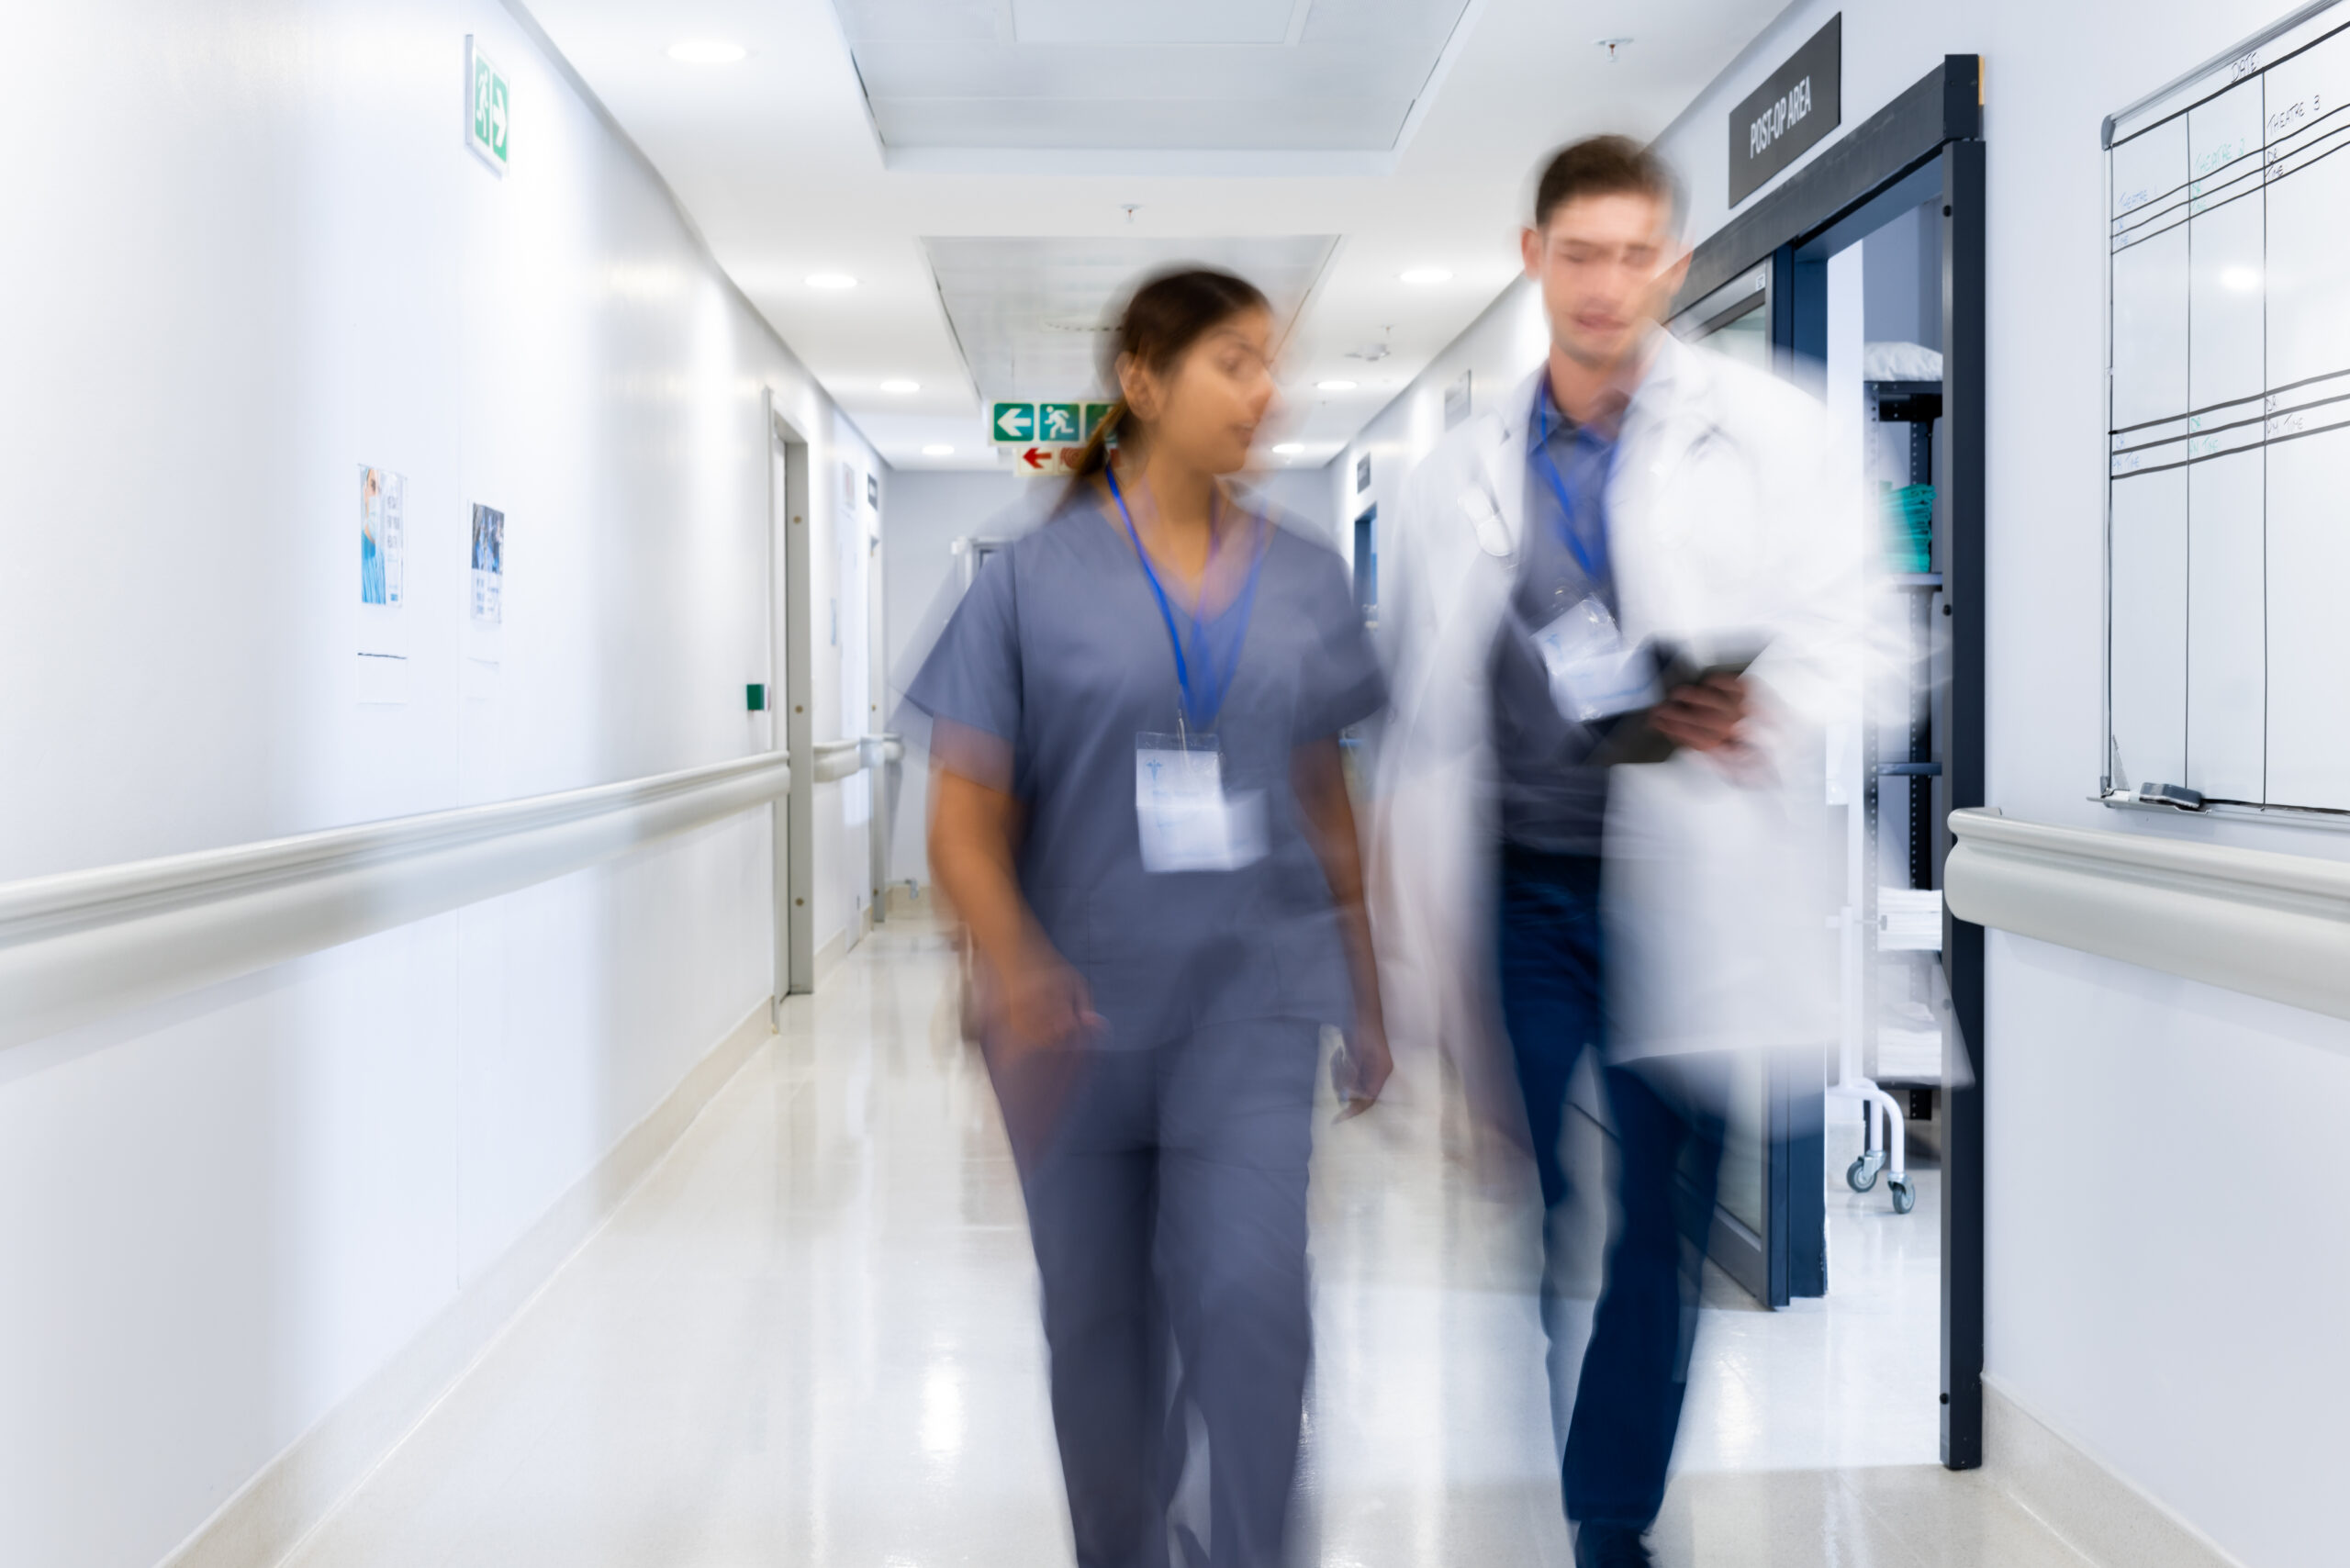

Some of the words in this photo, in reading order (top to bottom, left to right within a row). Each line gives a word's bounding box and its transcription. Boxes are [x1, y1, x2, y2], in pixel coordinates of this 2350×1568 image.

[1750, 96, 1787, 160] POST-OP
[1787, 75, 1812, 129] AREA
[2266, 101, 2306, 137] THEATRE
[2313, 95, 2321, 111] 3
